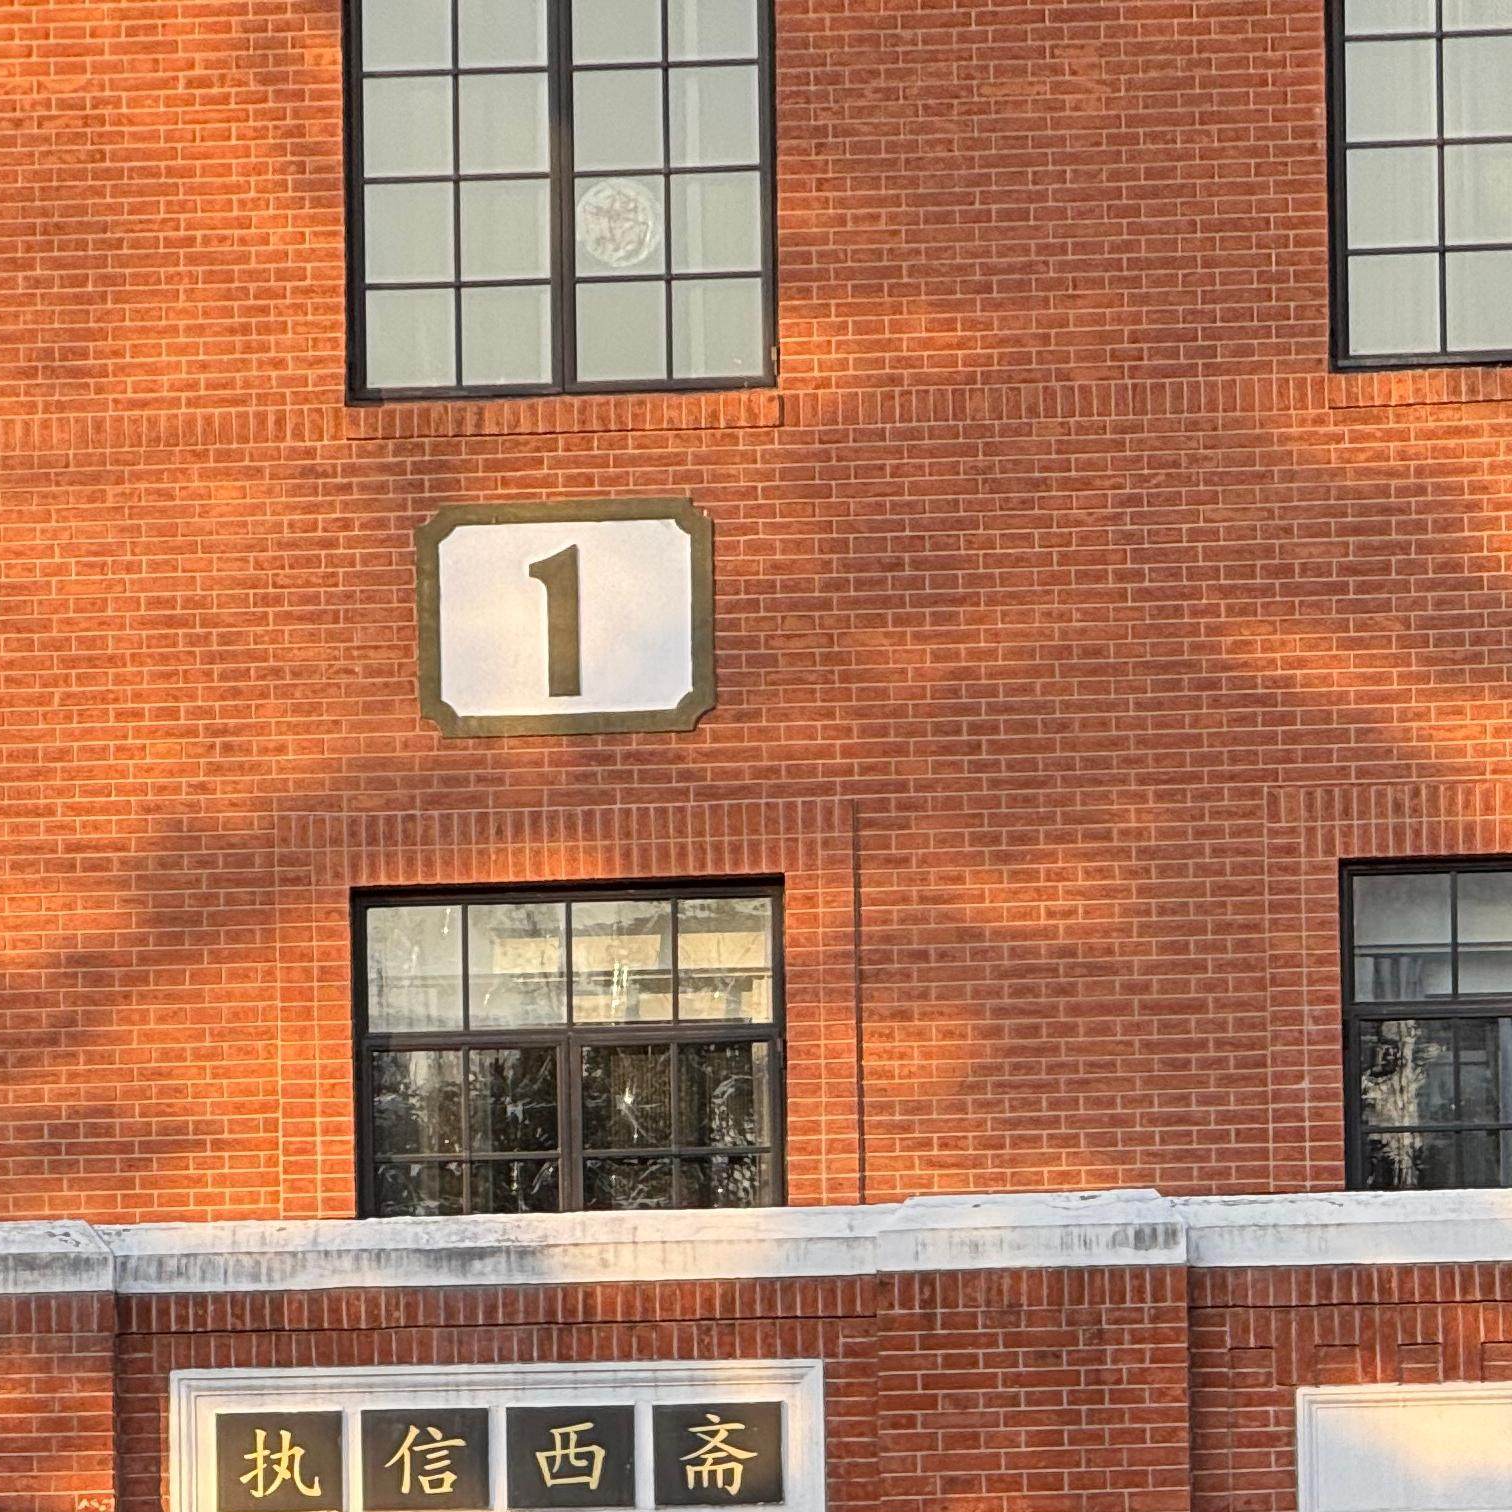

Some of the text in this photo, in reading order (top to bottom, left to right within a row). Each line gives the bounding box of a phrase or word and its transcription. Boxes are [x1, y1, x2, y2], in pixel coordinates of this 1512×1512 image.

[528, 543, 582, 697] 1
[239, 1413, 759, 1500] 执信西斋
